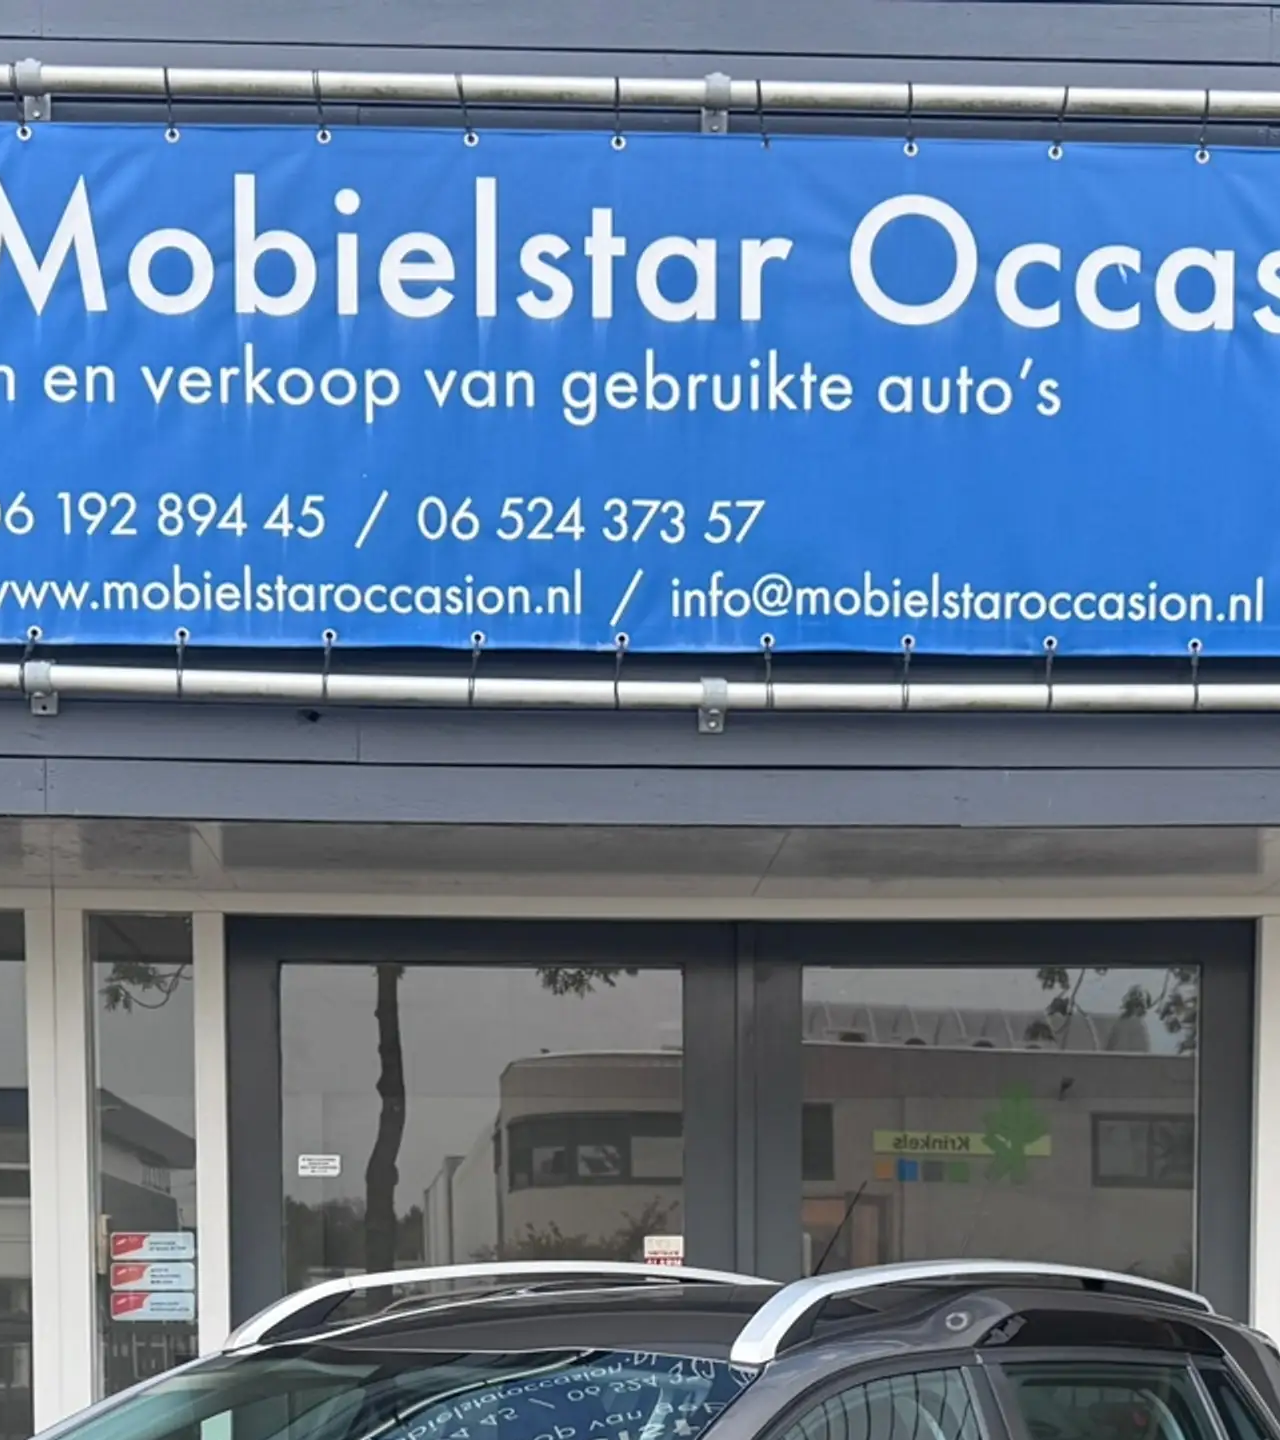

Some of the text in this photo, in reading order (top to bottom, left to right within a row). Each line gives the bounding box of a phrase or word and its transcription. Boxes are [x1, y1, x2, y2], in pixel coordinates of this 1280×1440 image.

[44, 365, 116, 403] en
[141, 342, 401, 424] verkoop
[424, 369, 536, 408] van
[562, 349, 853, 427] gebruikte
[878, 357, 1062, 416] auto's
[57, 491, 137, 536] 192
[158, 492, 248, 538] 894
[263, 494, 326, 539] 45
[354, 490, 389, 549] /
[418, 495, 480, 541] 06
[497, 497, 586, 542] 524
[602, 498, 686, 544] 373
[704, 500, 766, 544] 57
[609, 569, 644, 627] /
[672, 570, 1265, 625] info@mobielstaroccasion.nl
